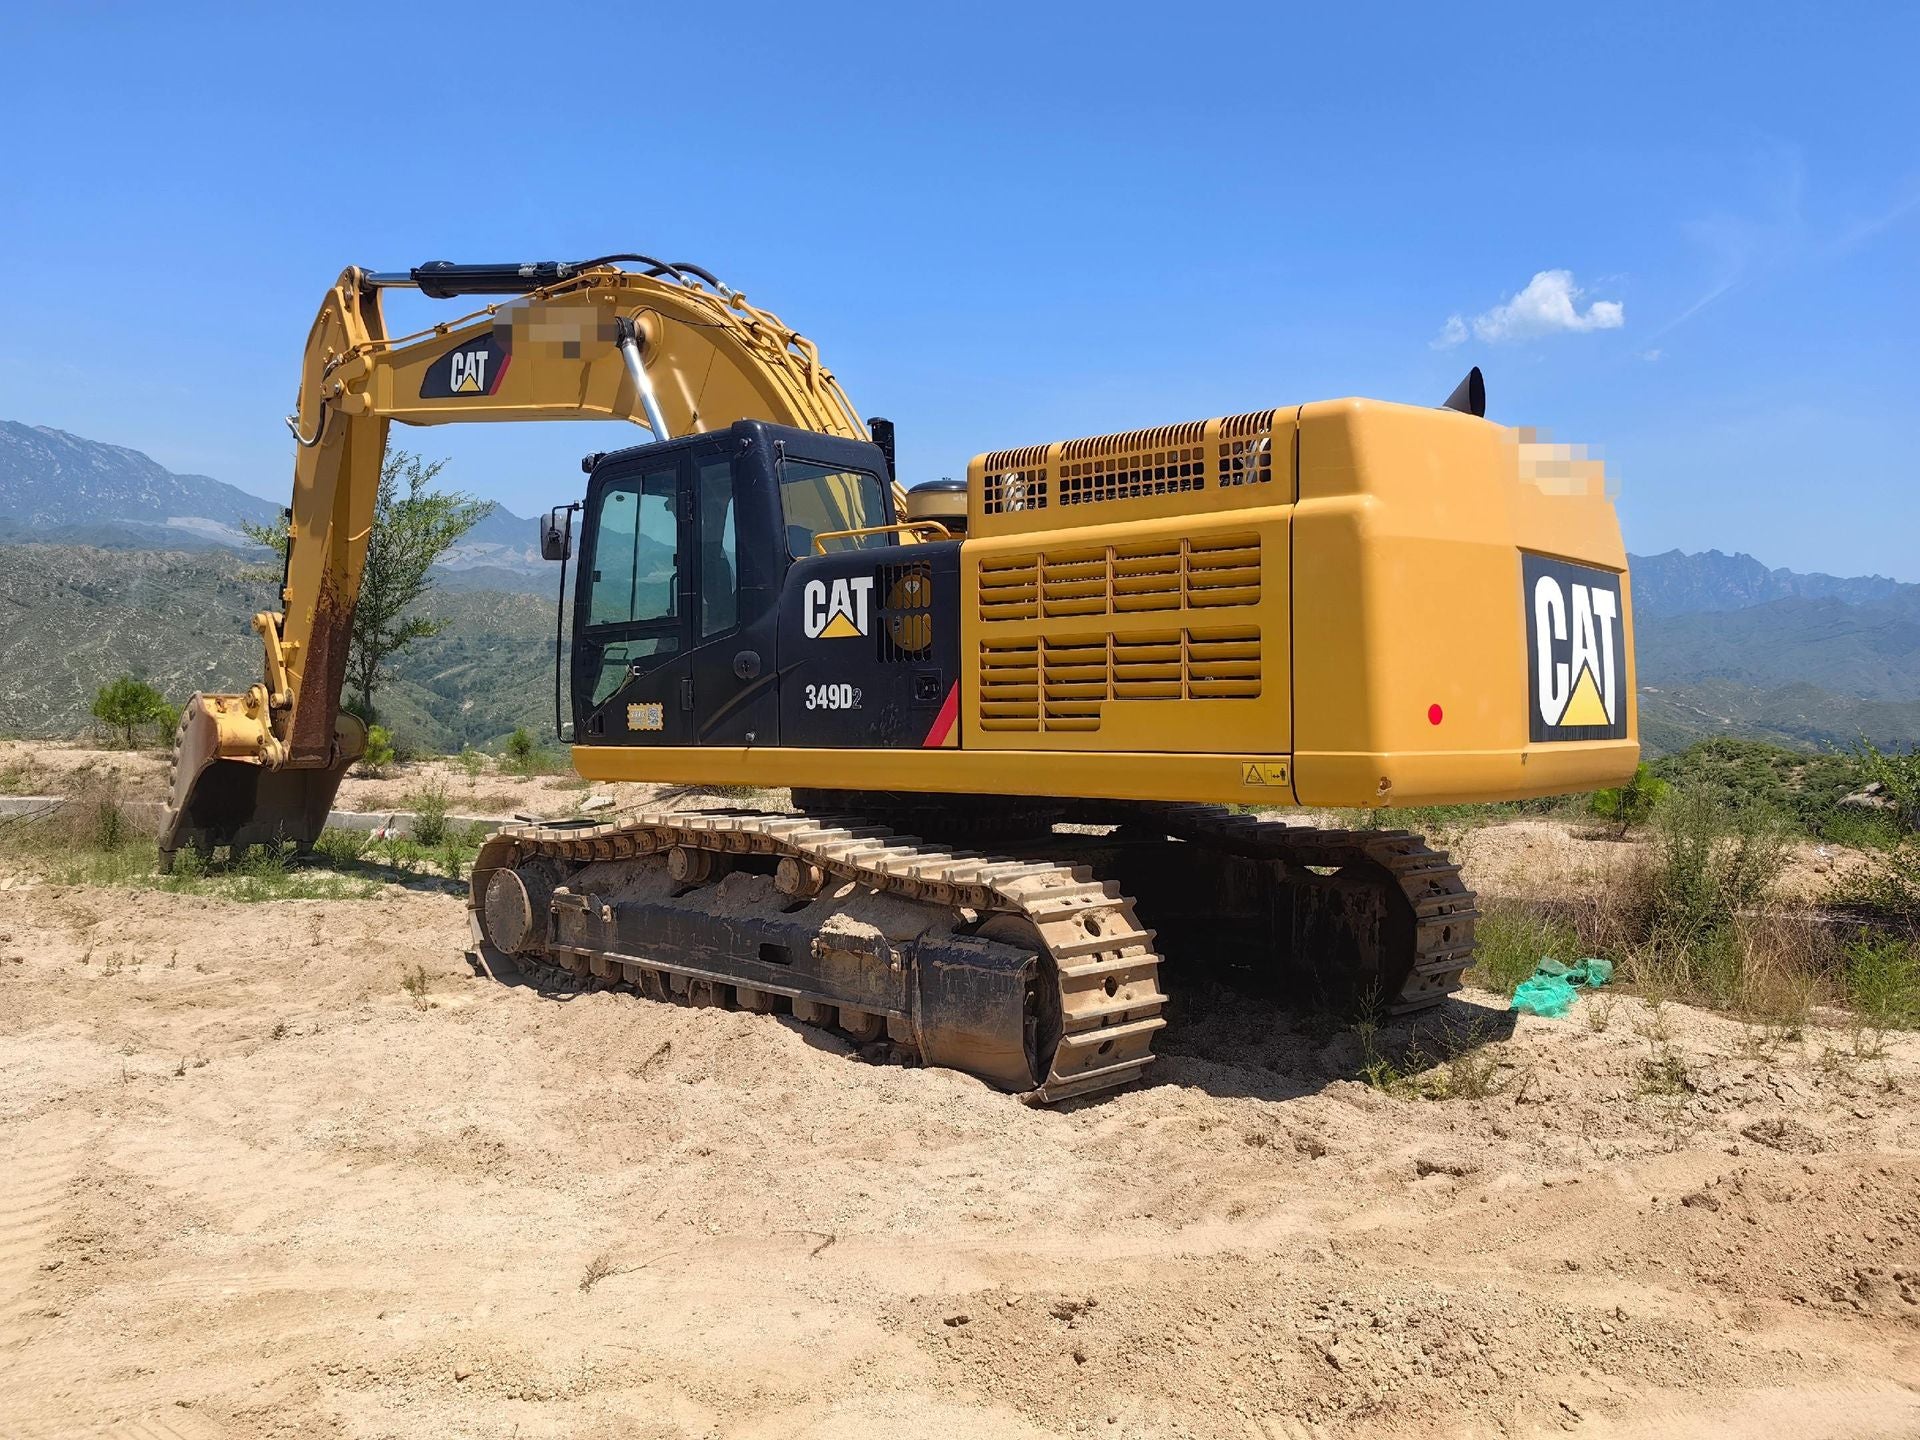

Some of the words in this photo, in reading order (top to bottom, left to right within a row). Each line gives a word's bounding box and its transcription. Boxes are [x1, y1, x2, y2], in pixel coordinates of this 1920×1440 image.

[450, 351, 489, 393] CAT
[804, 576, 874, 639] CAT
[1534, 575, 1617, 727] CAT
[805, 684, 863, 711] 349D2
